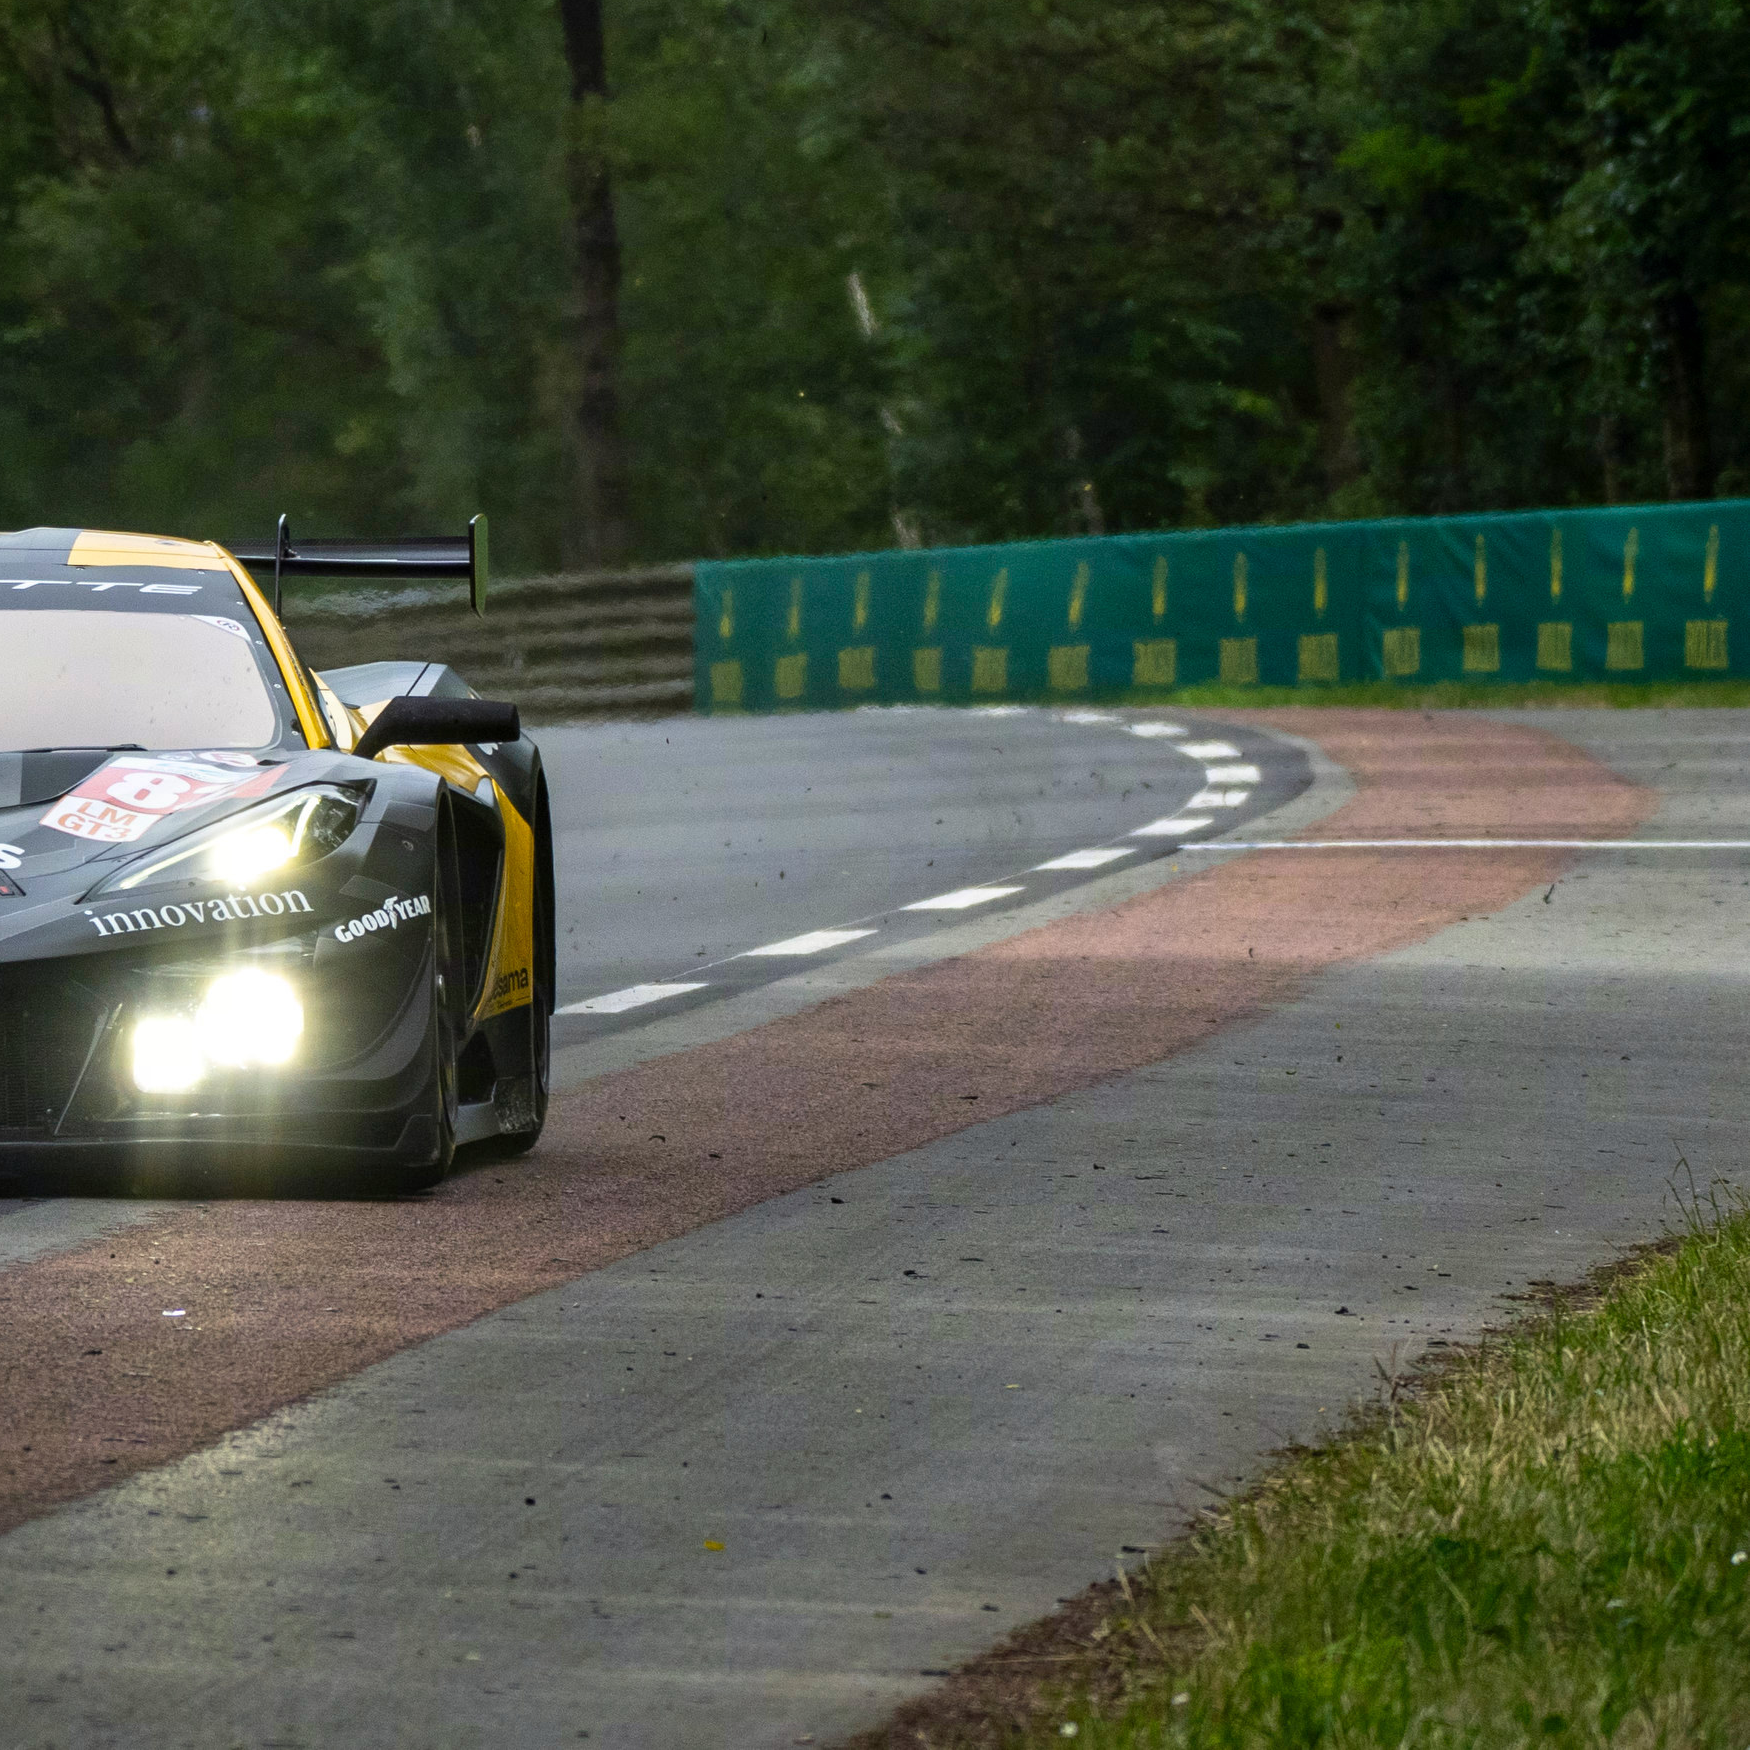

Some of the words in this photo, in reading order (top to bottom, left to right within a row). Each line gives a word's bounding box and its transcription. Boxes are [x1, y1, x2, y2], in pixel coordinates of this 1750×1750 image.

[56, 813, 132, 841] GT3
[76, 800, 138, 826] LM
[84, 884, 315, 937] innovation
[333, 893, 432, 944] GOODYEAR
